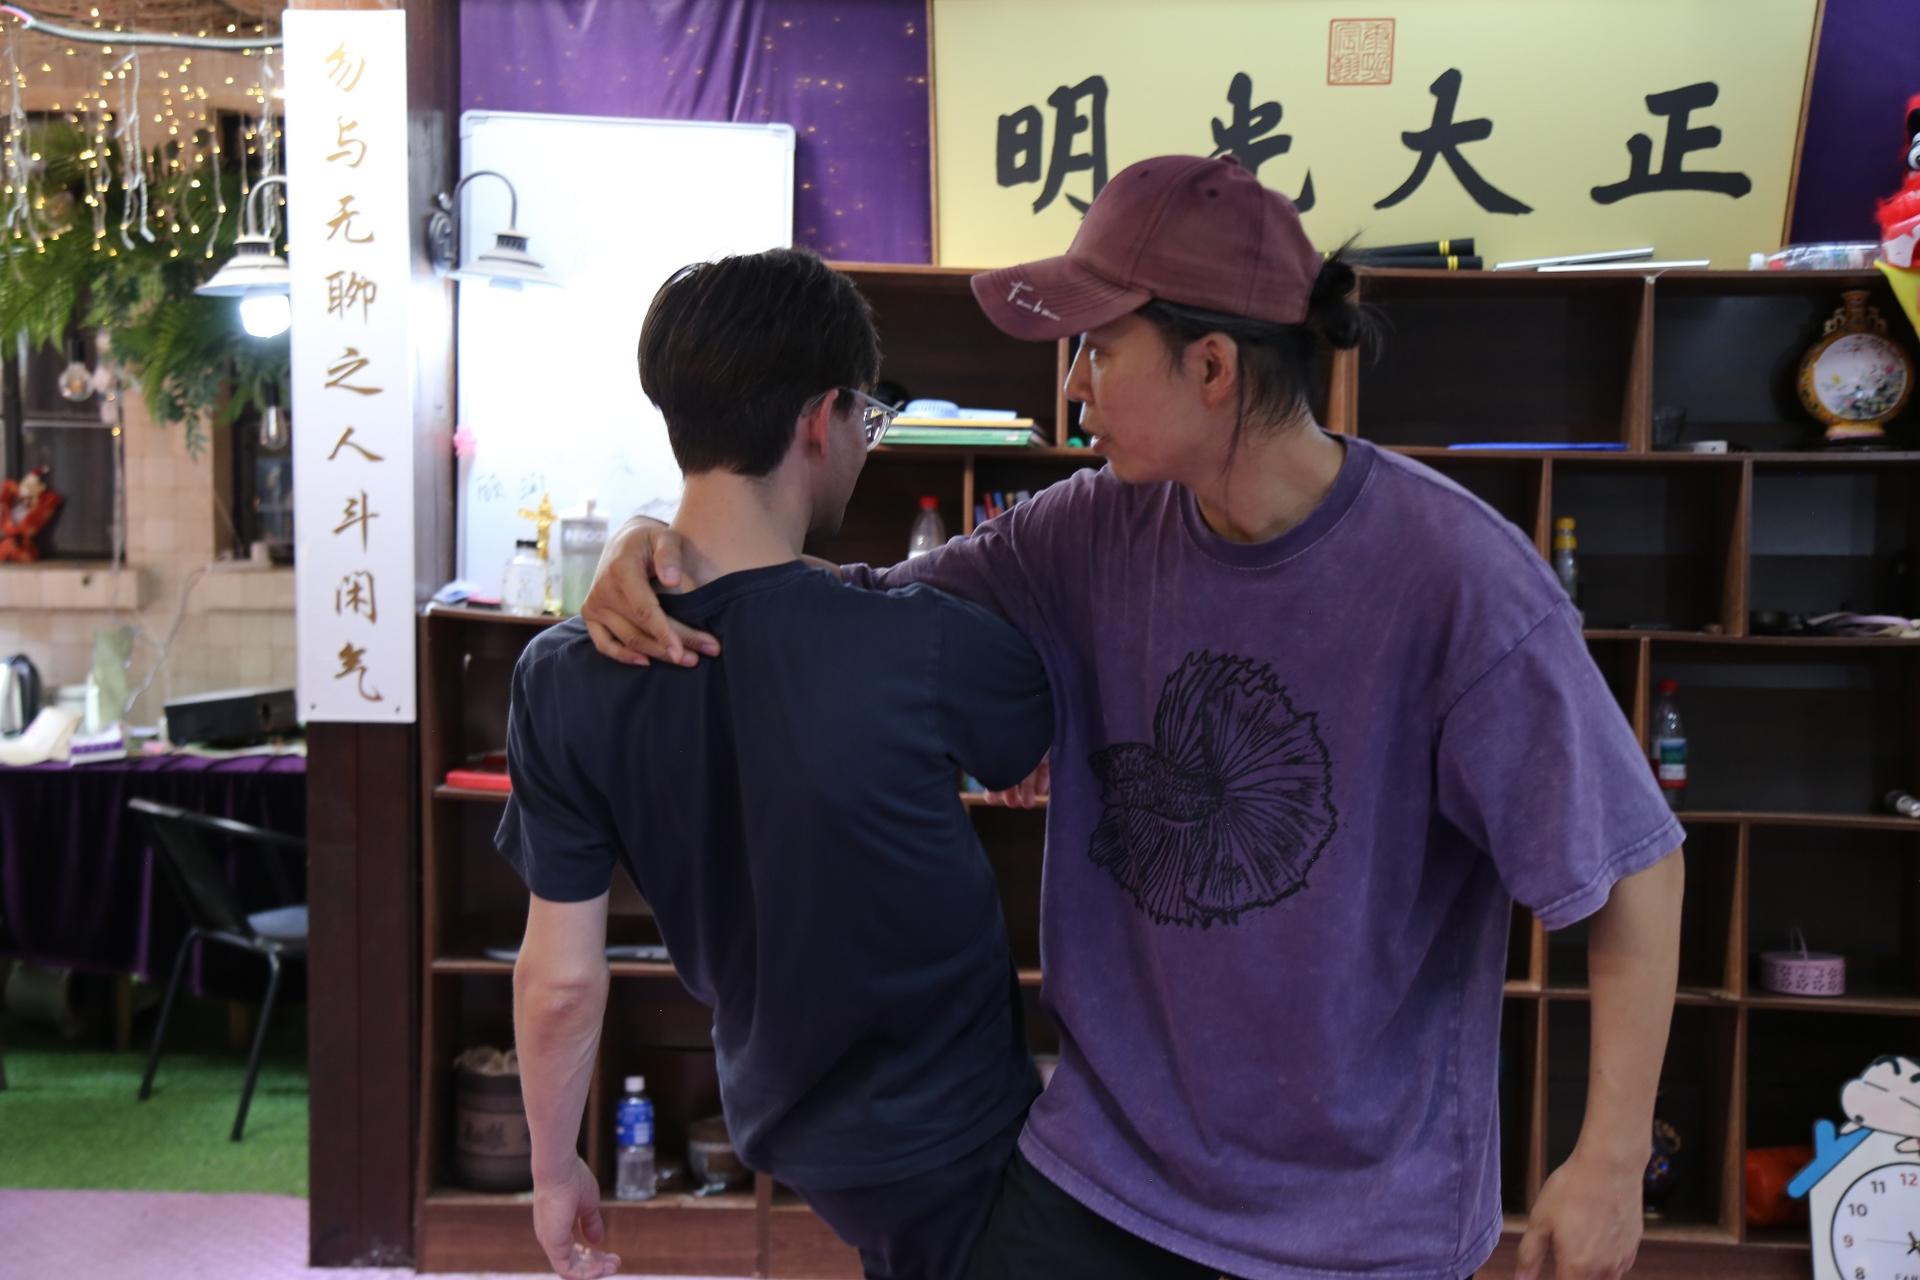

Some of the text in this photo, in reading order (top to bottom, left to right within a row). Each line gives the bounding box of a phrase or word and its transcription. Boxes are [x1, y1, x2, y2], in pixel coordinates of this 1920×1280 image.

[324, 41, 385, 703] 勿与无聊之人斗闲气
[1870, 1180, 1886, 1194] 11
[1900, 1173, 1918, 1187] 12
[1848, 1203, 1868, 1218] 10
[1843, 1234, 1854, 1248] 9
[1855, 1266, 1866, 1280] 8
